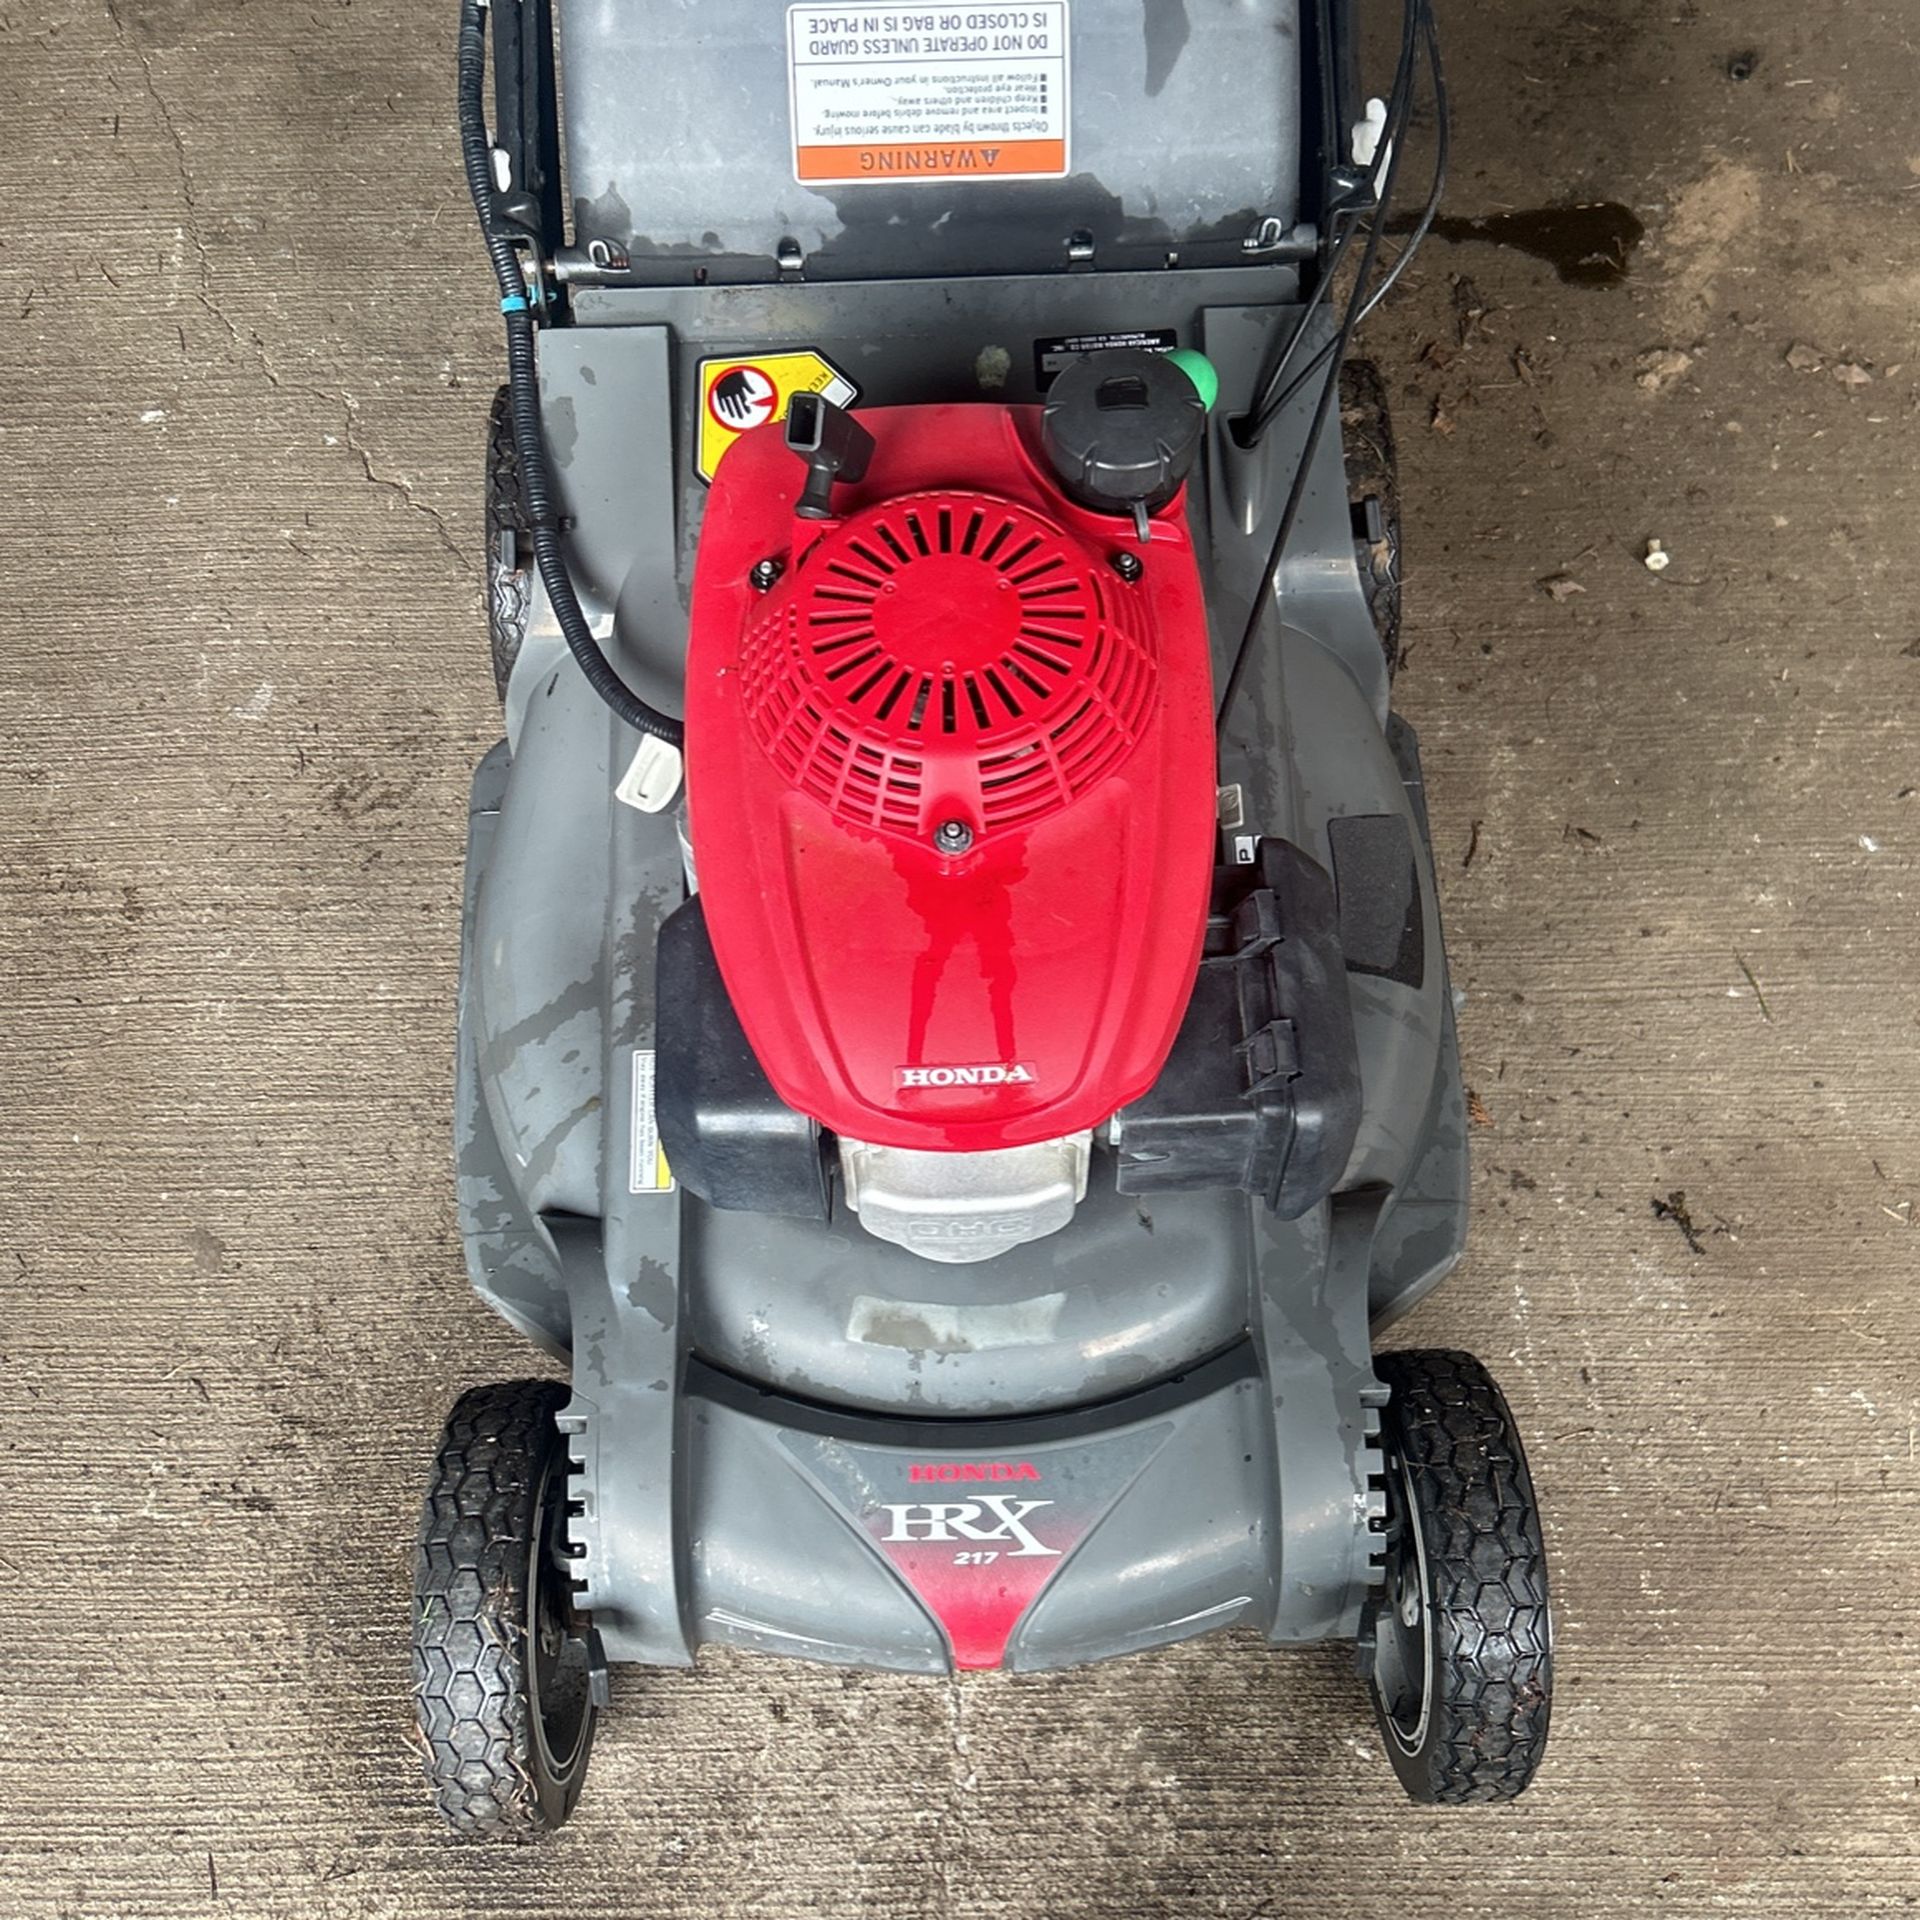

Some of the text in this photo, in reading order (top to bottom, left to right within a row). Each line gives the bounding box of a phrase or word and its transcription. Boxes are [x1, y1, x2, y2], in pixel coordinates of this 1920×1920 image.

[808, 12, 1047, 34] IS CLOSED OR BAG IS IN PLACE
[808, 34, 1048, 56] DO NOT OPERATE UNLESS GUARD
[852, 78, 892, 87] Owner's
[895, 74, 917, 84] your
[919, 77, 929, 86] in
[932, 75, 988, 85] instructions
[992, 74, 1004, 84] all
[1007, 74, 1037, 83] Follow
[944, 83, 1037, 94] Wear eye protection.
[924, 97, 952, 106] others
[955, 96, 972, 106] and
[974, 95, 1012, 105] children
[1014, 94, 1038, 104] Keep
[862, 110, 892, 119] before
[894, 108, 922, 118] debris
[926, 108, 960, 116] remove
[962, 107, 979, 116] and
[982, 106, 1002, 114] area
[1005, 105, 1038, 116] Inspect
[813, 120, 1048, 138] Objects thrown by blade can cause serious injury.
[860, 150, 976, 170] WARNING
[902, 1064, 1032, 1086] HONDA
[908, 1462, 1041, 1484] HONDA
[880, 1494, 1062, 1556] HRX
[953, 1552, 1000, 1565] 217
